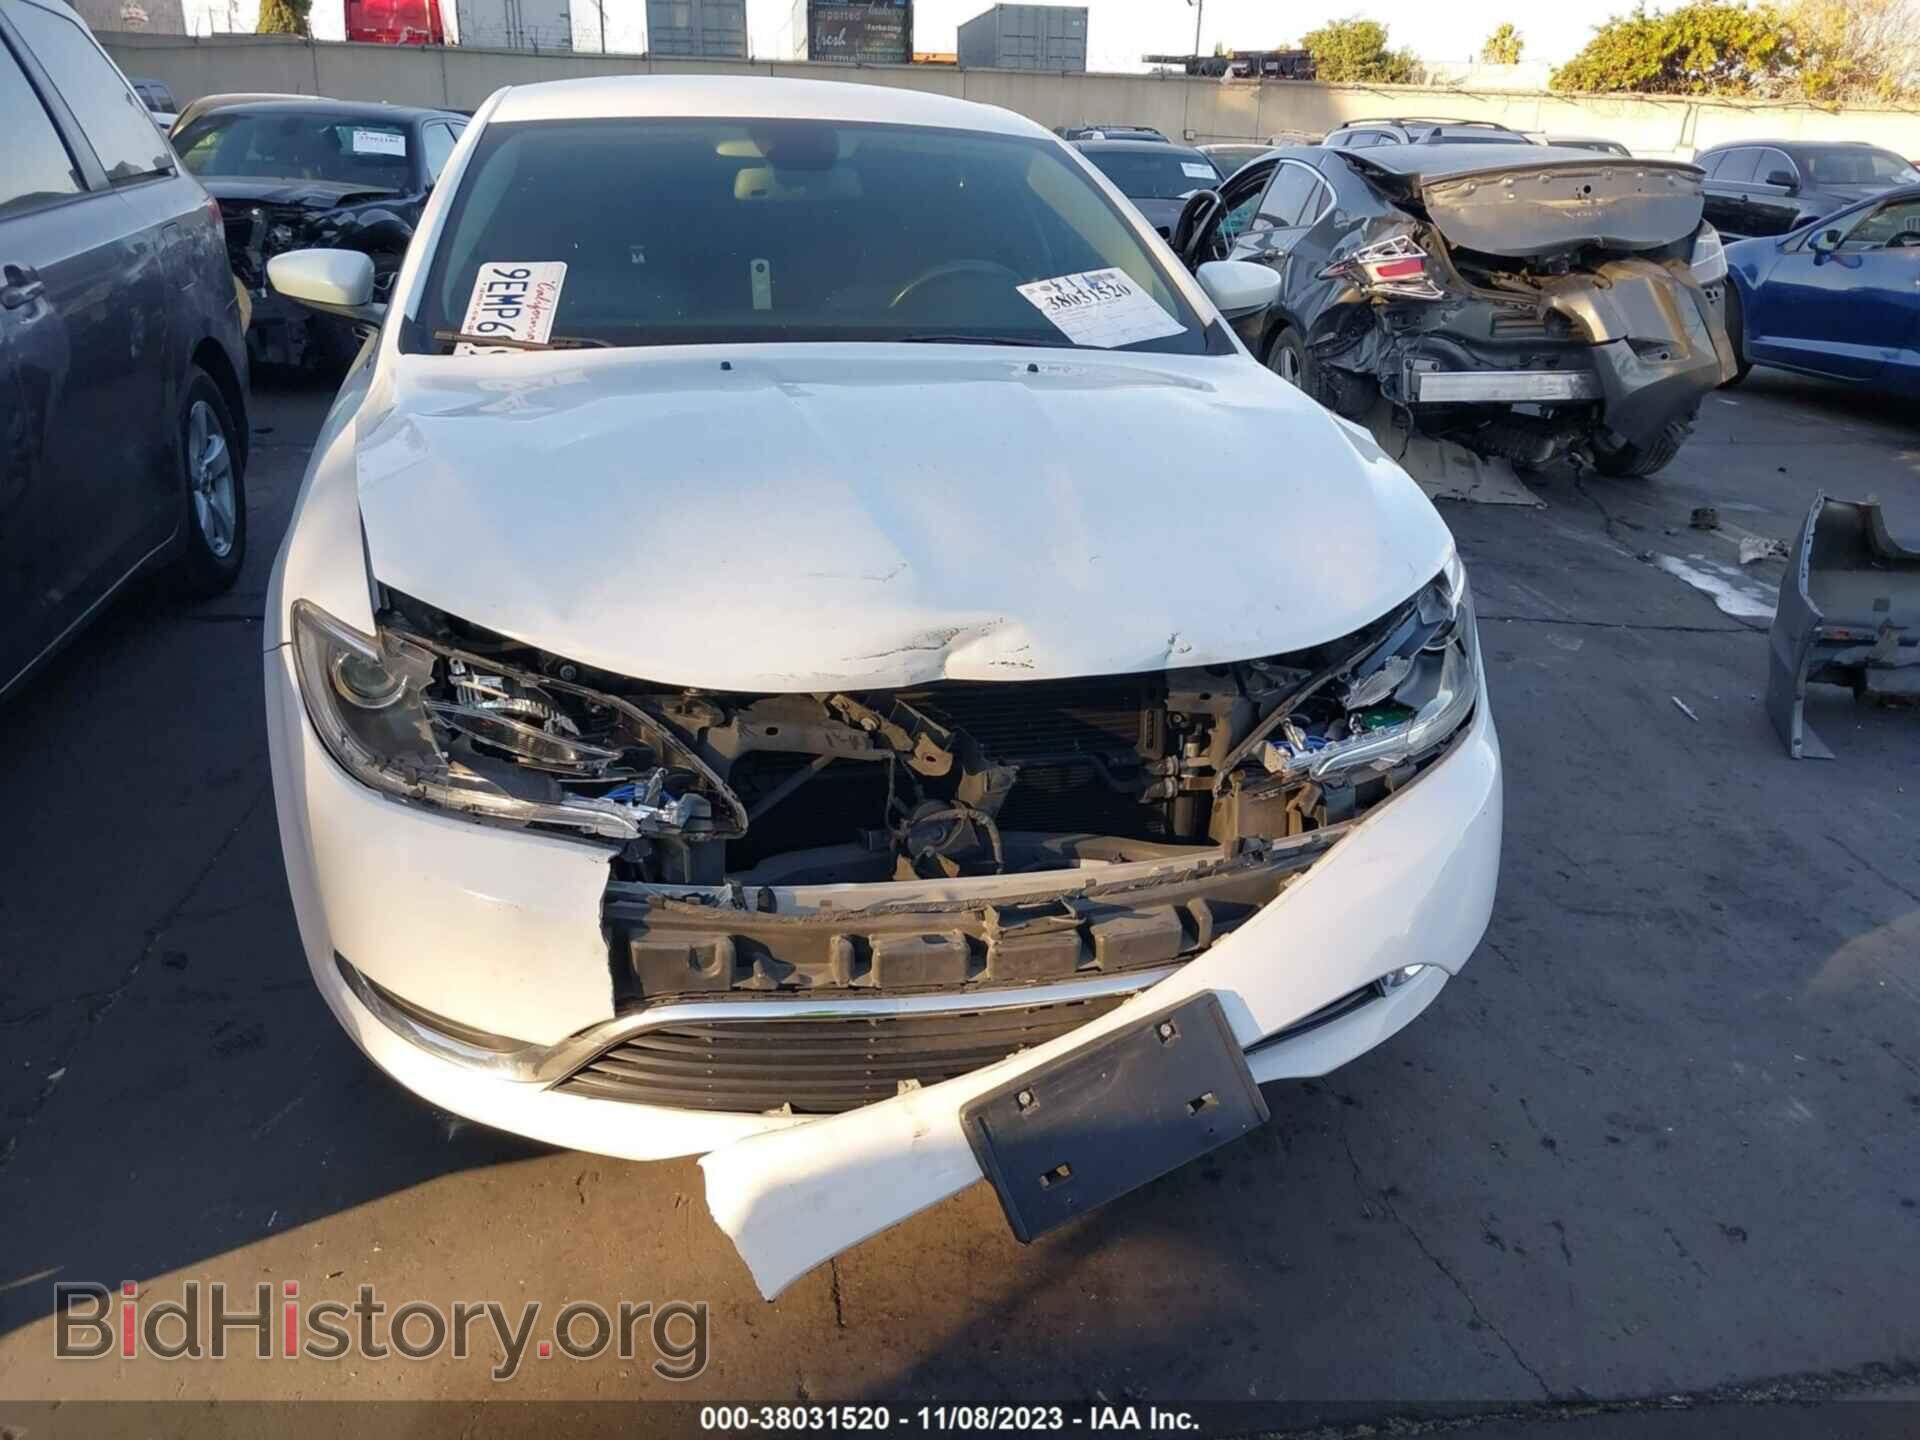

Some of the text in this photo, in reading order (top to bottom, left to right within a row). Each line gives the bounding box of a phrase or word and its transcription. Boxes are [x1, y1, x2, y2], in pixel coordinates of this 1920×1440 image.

[815, 26, 847, 52] fresh
[468, 268, 532, 354] 9EMP6
[526, 281, 557, 341] California
[1045, 282, 1133, 311] 38031520
